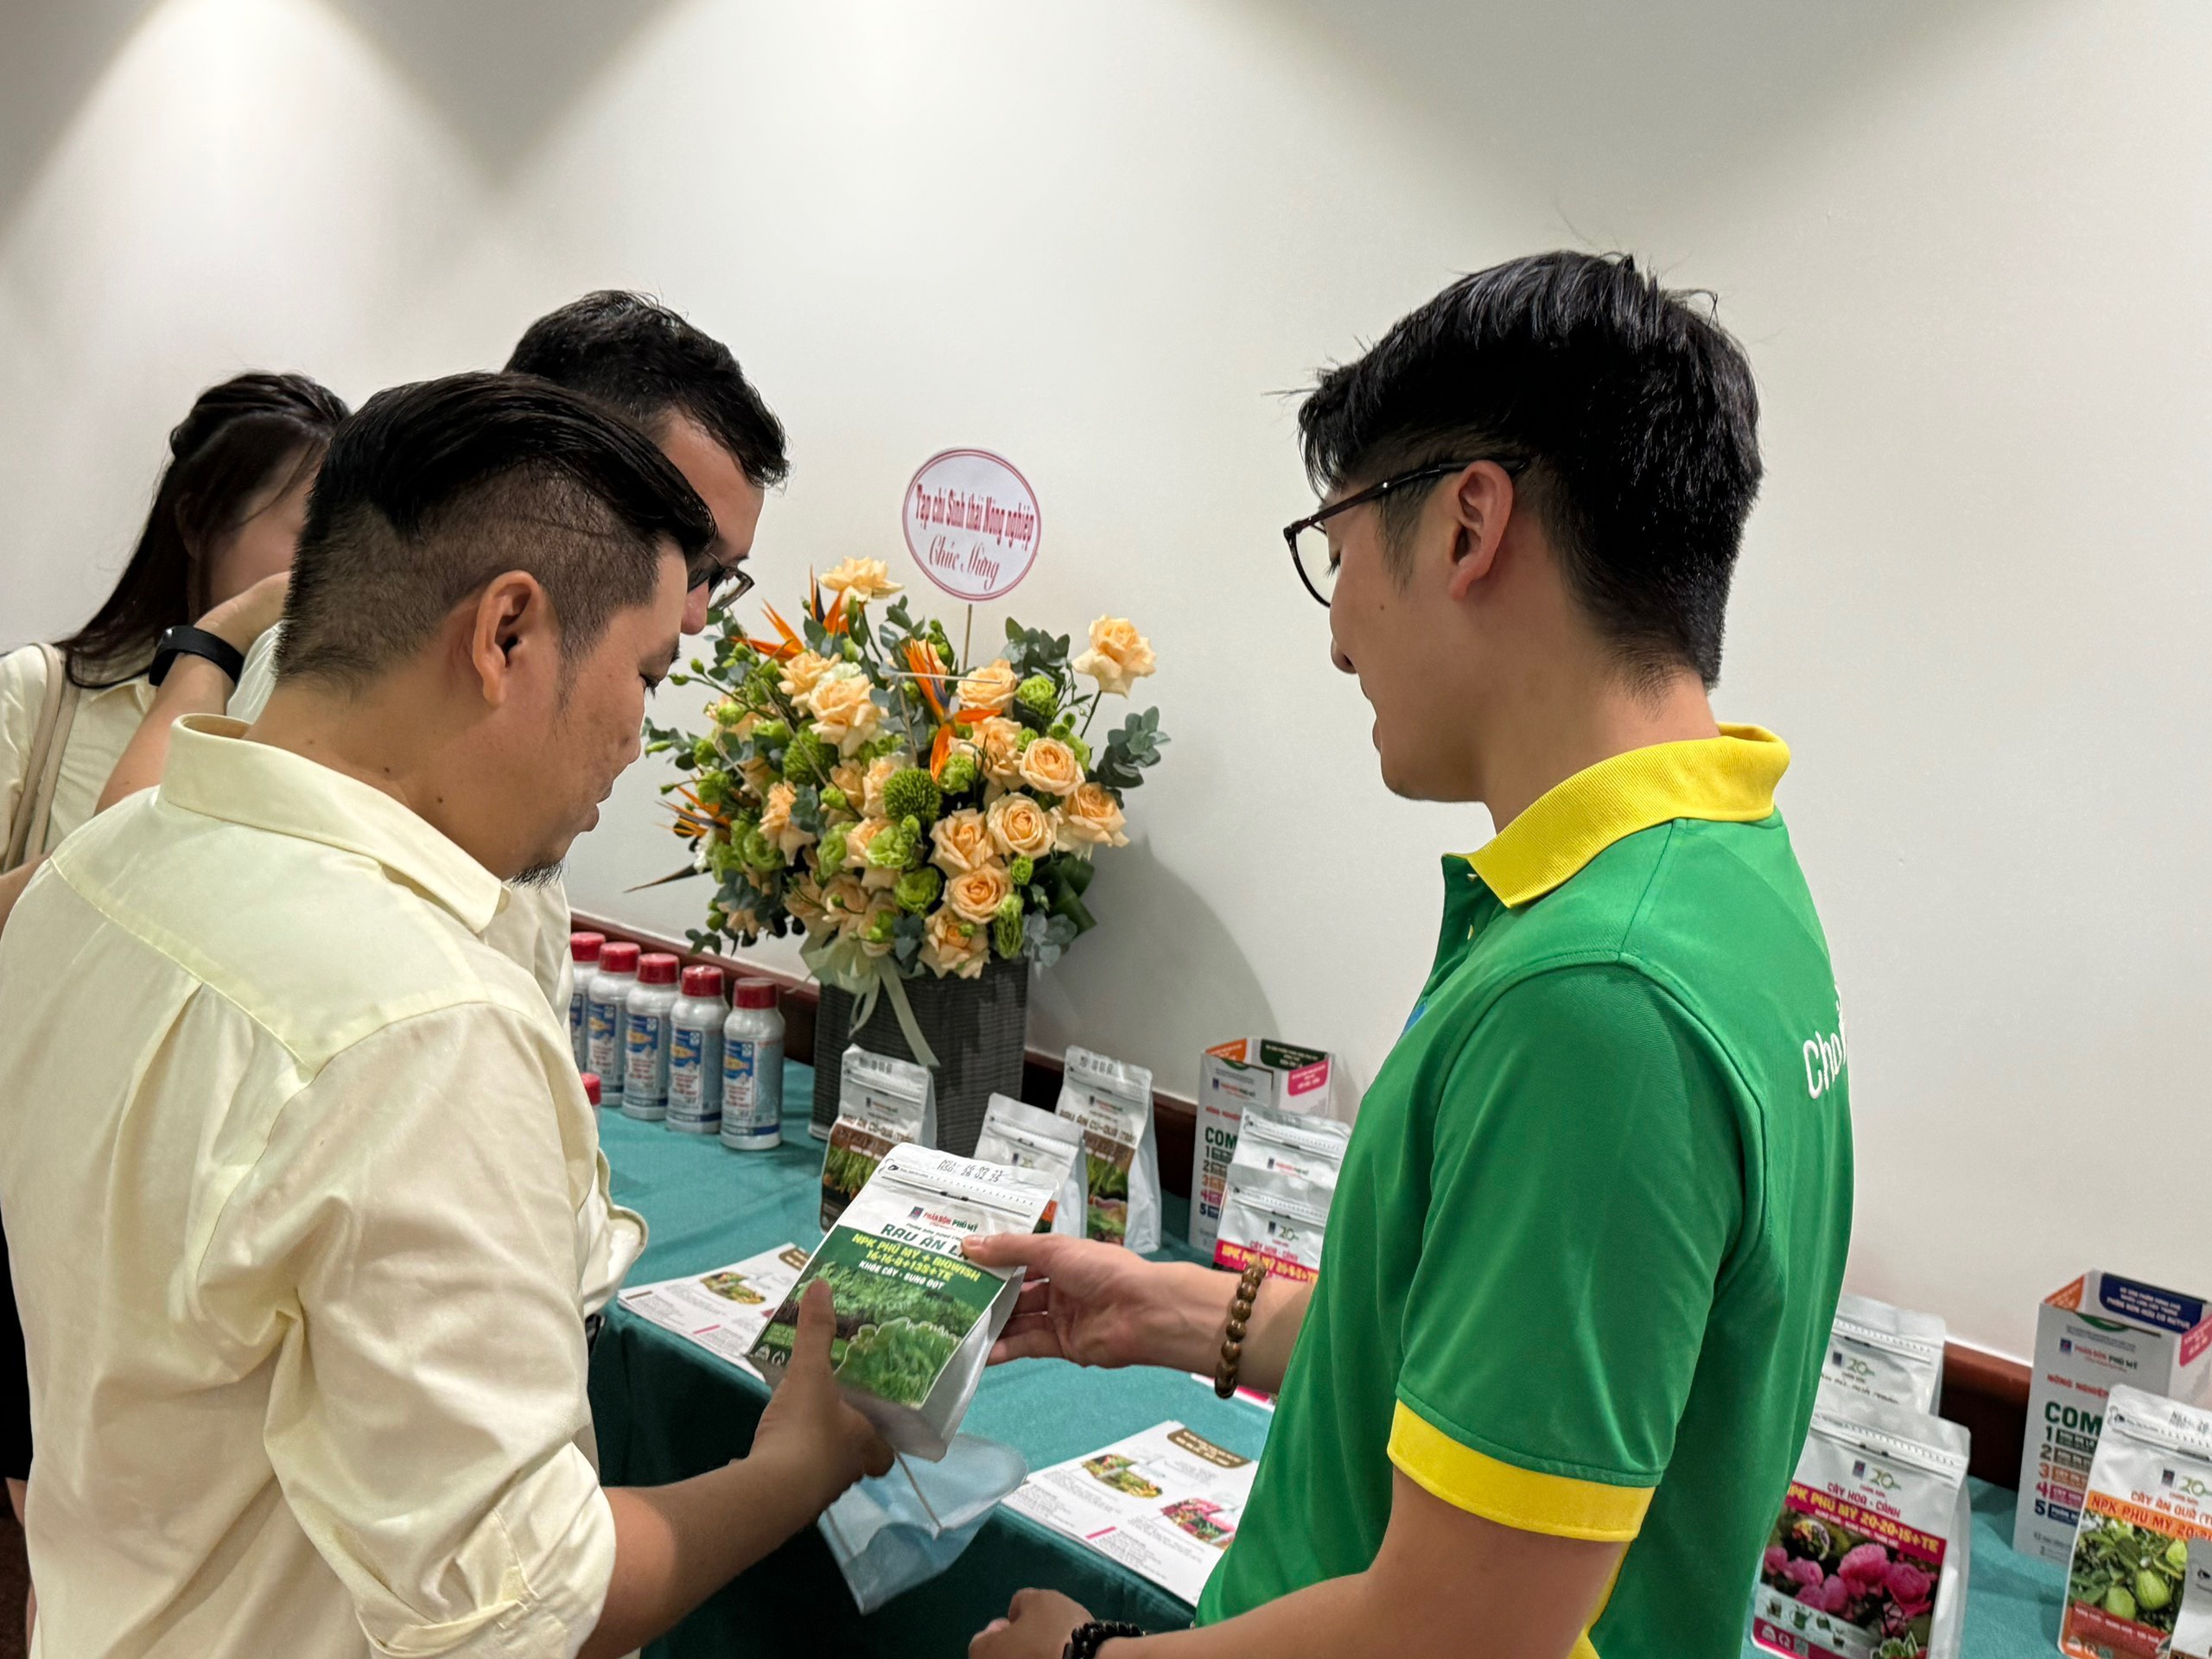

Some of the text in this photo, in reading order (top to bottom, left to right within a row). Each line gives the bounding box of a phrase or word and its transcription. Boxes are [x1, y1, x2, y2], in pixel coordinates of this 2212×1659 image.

[946, 488, 965, 529] Sinh
[929, 534, 960, 571] Chúc
[851, 1233, 878, 1249] NPK
[880, 1224, 918, 1242] RAU
[918, 1235, 947, 1251] ĂN
[2040, 1443, 2052, 1461] 2
[2038, 1461, 2050, 1480] 3
[1827, 1481, 1846, 1497] CÂY
[1847, 1489, 1867, 1506] HOA
[2130, 1490, 2154, 1506] CÂY
[2034, 1498, 2047, 1516] 5
[2091, 1496, 2118, 1513] NPK
